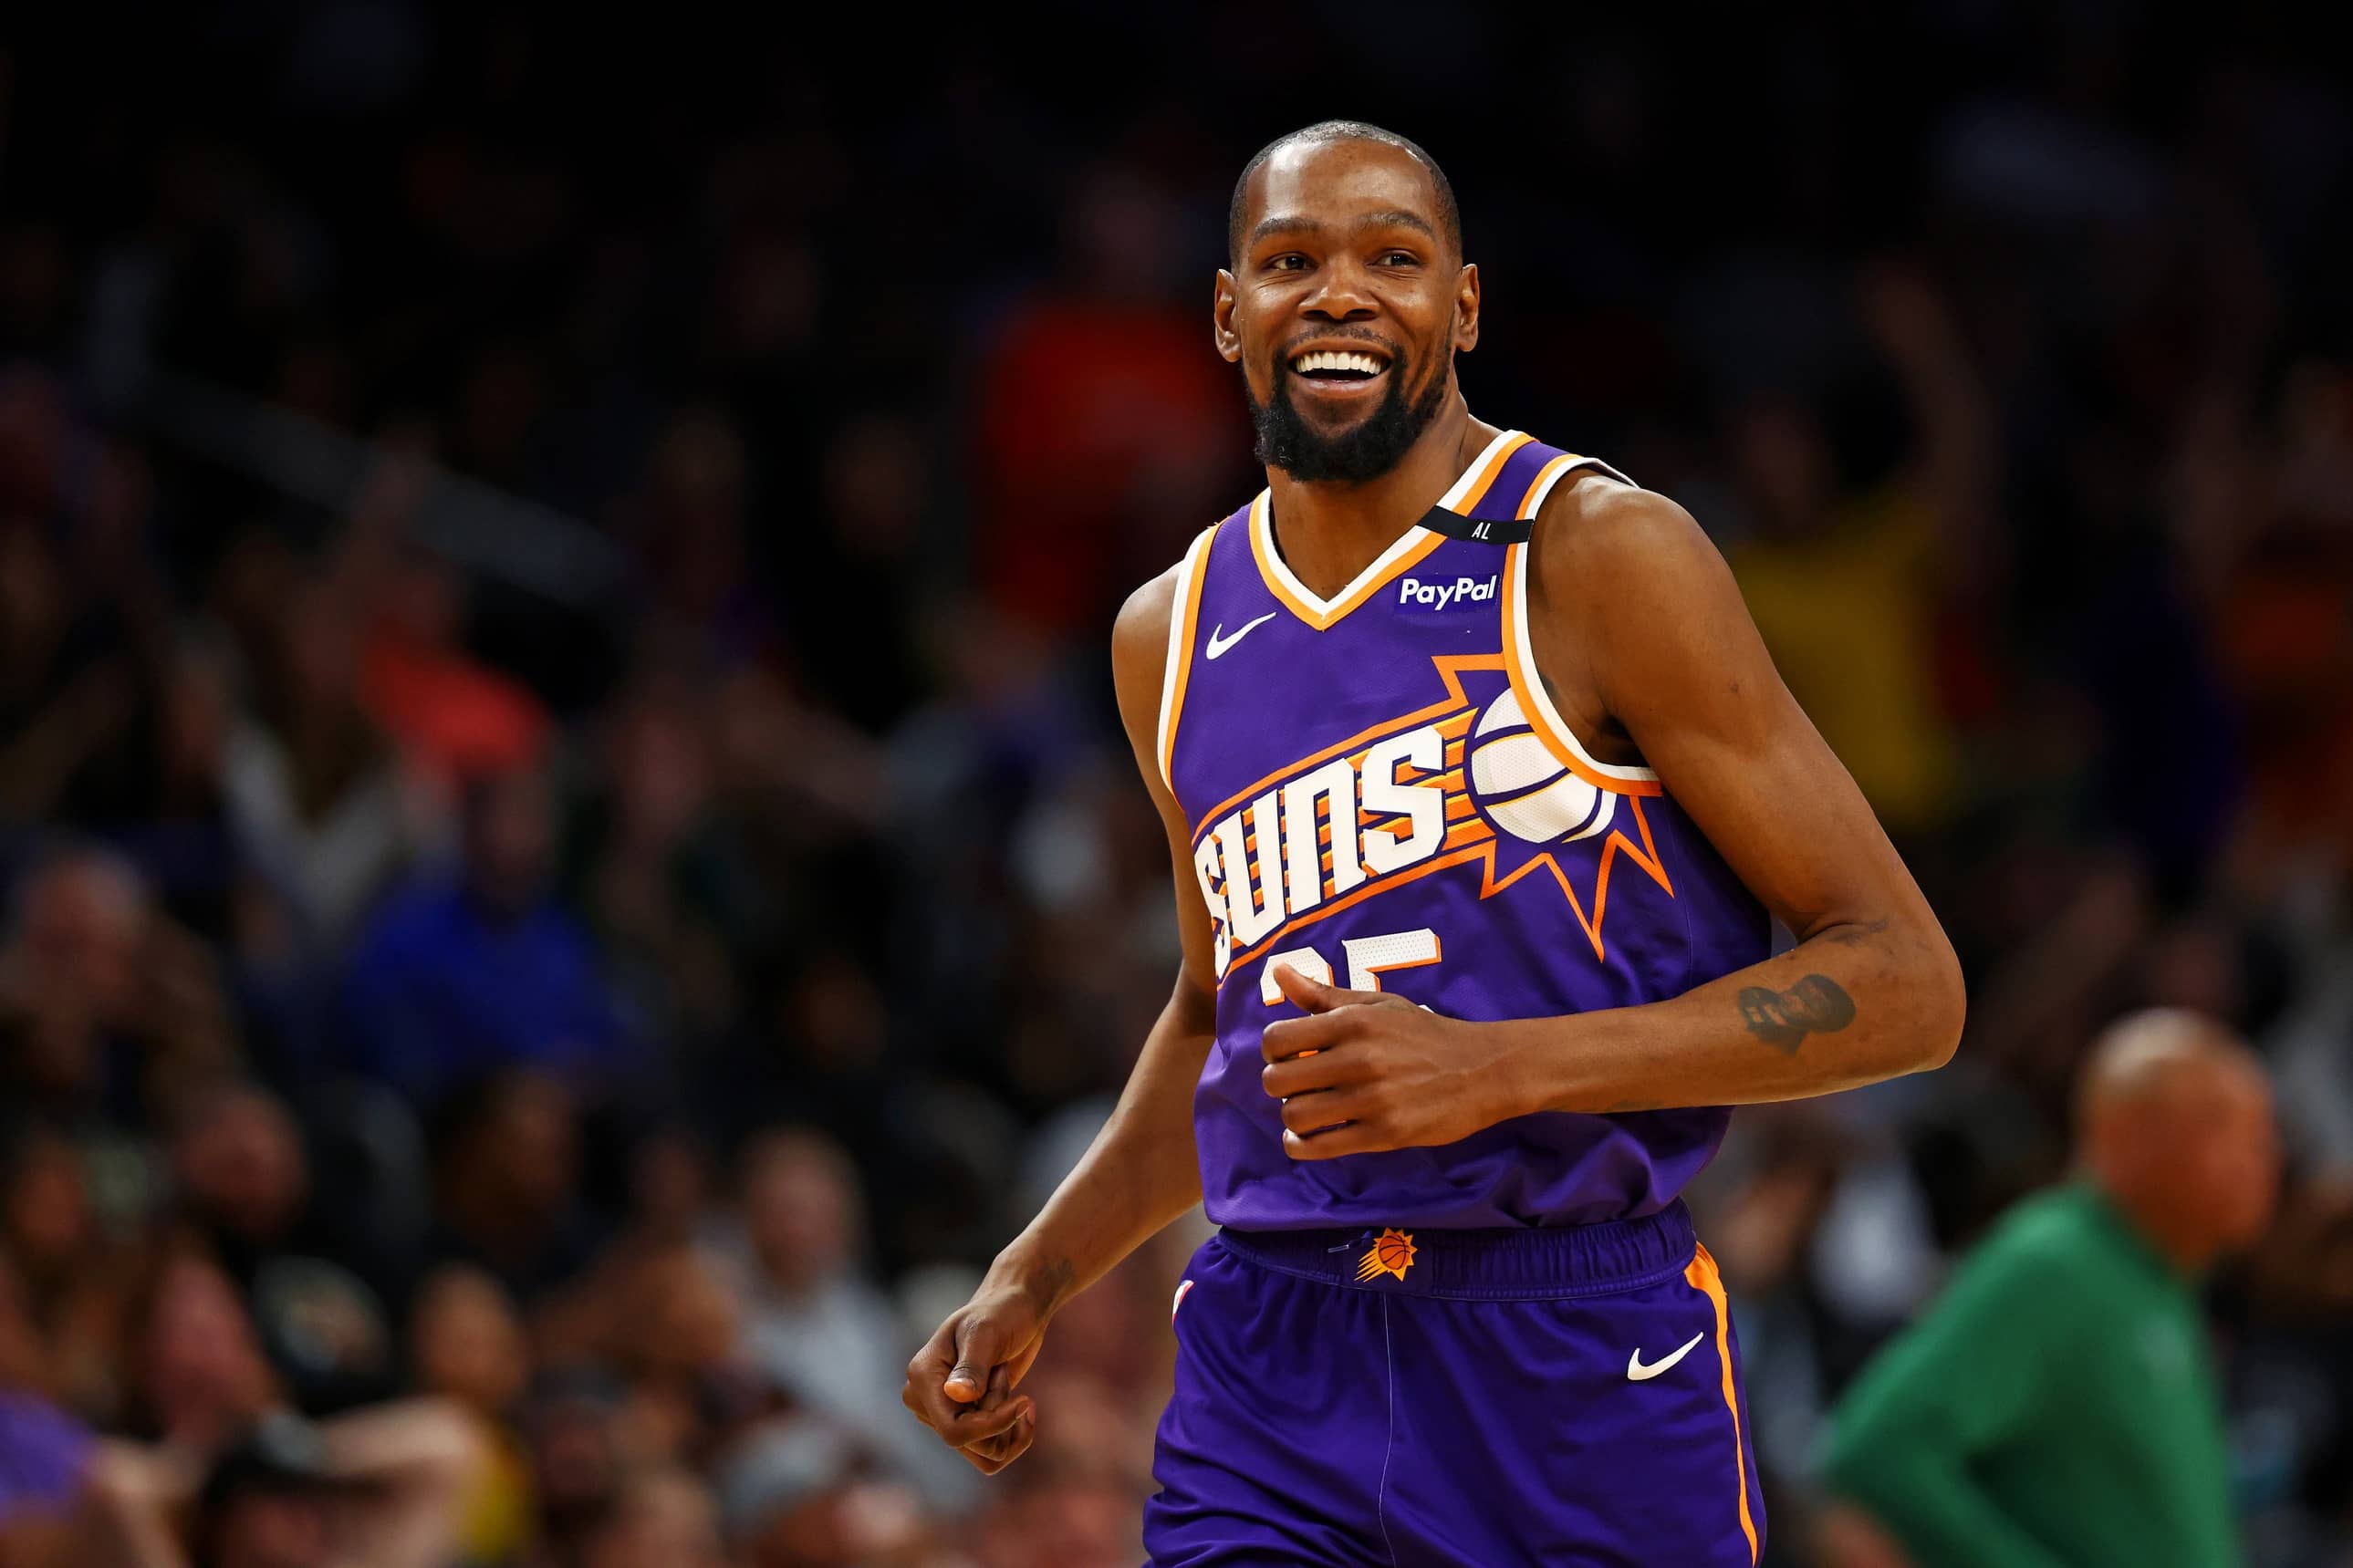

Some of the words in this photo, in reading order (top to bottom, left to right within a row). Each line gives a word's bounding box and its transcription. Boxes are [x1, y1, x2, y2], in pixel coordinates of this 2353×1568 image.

[1472, 522, 1491, 540] AL
[1400, 575, 1497, 611] PayPal
[1194, 725, 1444, 980] SUNS
